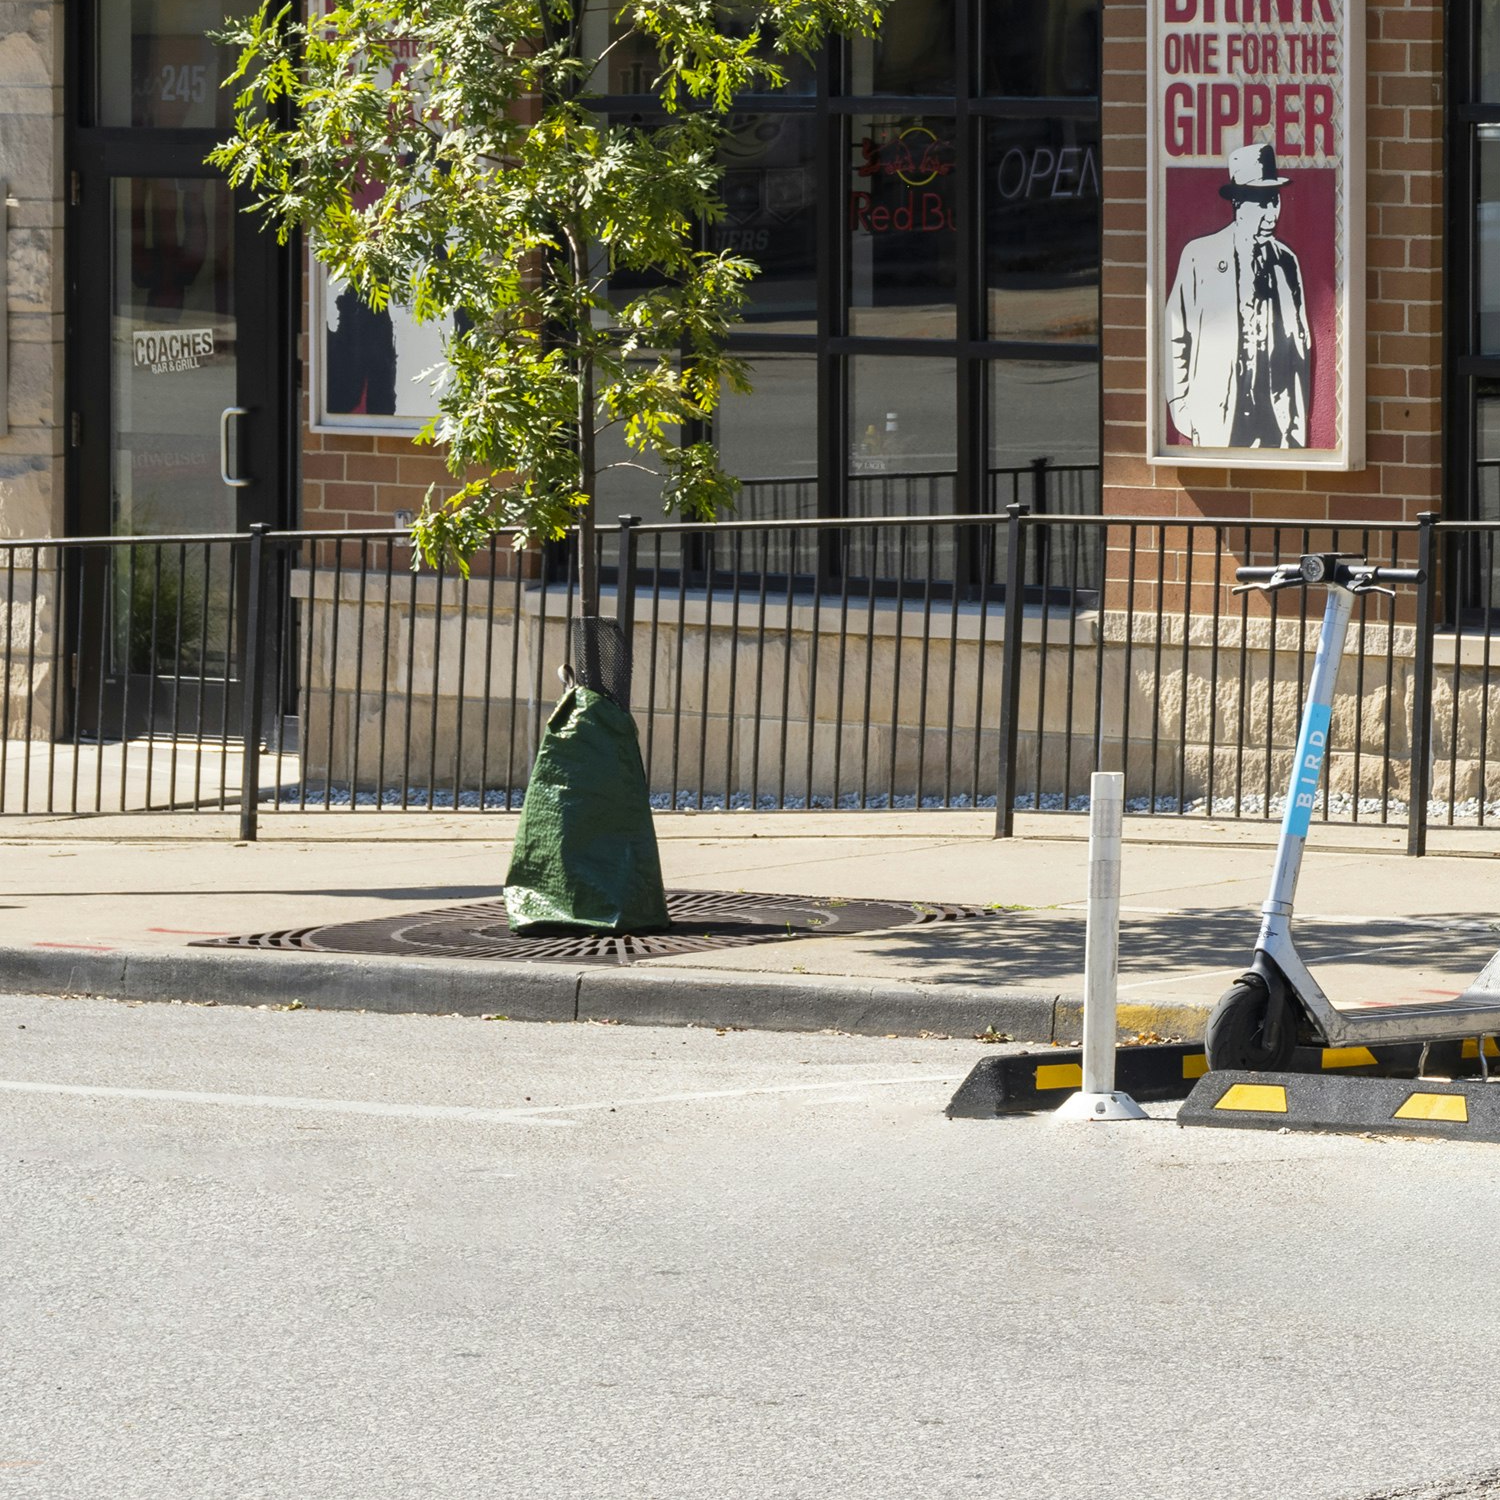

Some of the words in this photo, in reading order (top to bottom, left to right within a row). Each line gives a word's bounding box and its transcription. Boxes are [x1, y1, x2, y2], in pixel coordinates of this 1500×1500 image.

[1165, 33, 1218, 74] ONE
[1227, 33, 1278, 74] FOR
[1285, 34, 1336, 74] THE
[161, 64, 206, 103] 245
[1165, 83, 1335, 157] GIPPER
[852, 191, 914, 232] Red
[134, 332, 213, 365] COACHES
[152, 361, 168, 375] BAR
[175, 357, 200, 372] GRILL
[132, 452, 208, 468] dweiser
[1296, 730, 1325, 808] BIRD
